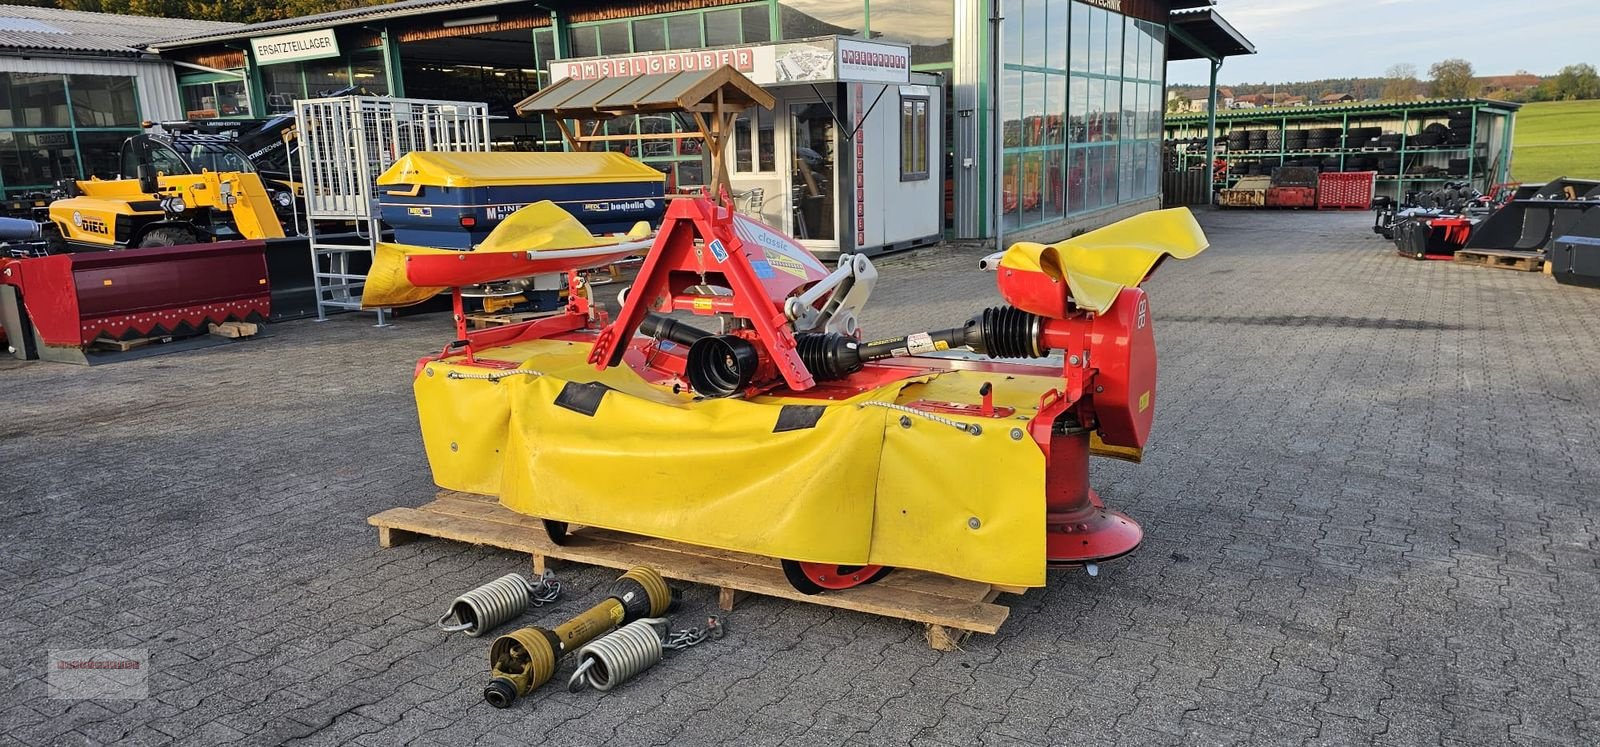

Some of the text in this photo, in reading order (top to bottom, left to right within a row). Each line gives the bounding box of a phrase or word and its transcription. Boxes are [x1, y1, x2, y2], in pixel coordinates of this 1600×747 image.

[258, 37, 331, 56] ERSATZTEILLAGER
[569, 52, 751, 78] AMSELGRUBER
[842, 49, 906, 69] AMSELGRUBER
[487, 207, 496, 220] M
[758, 232, 788, 251] classic
